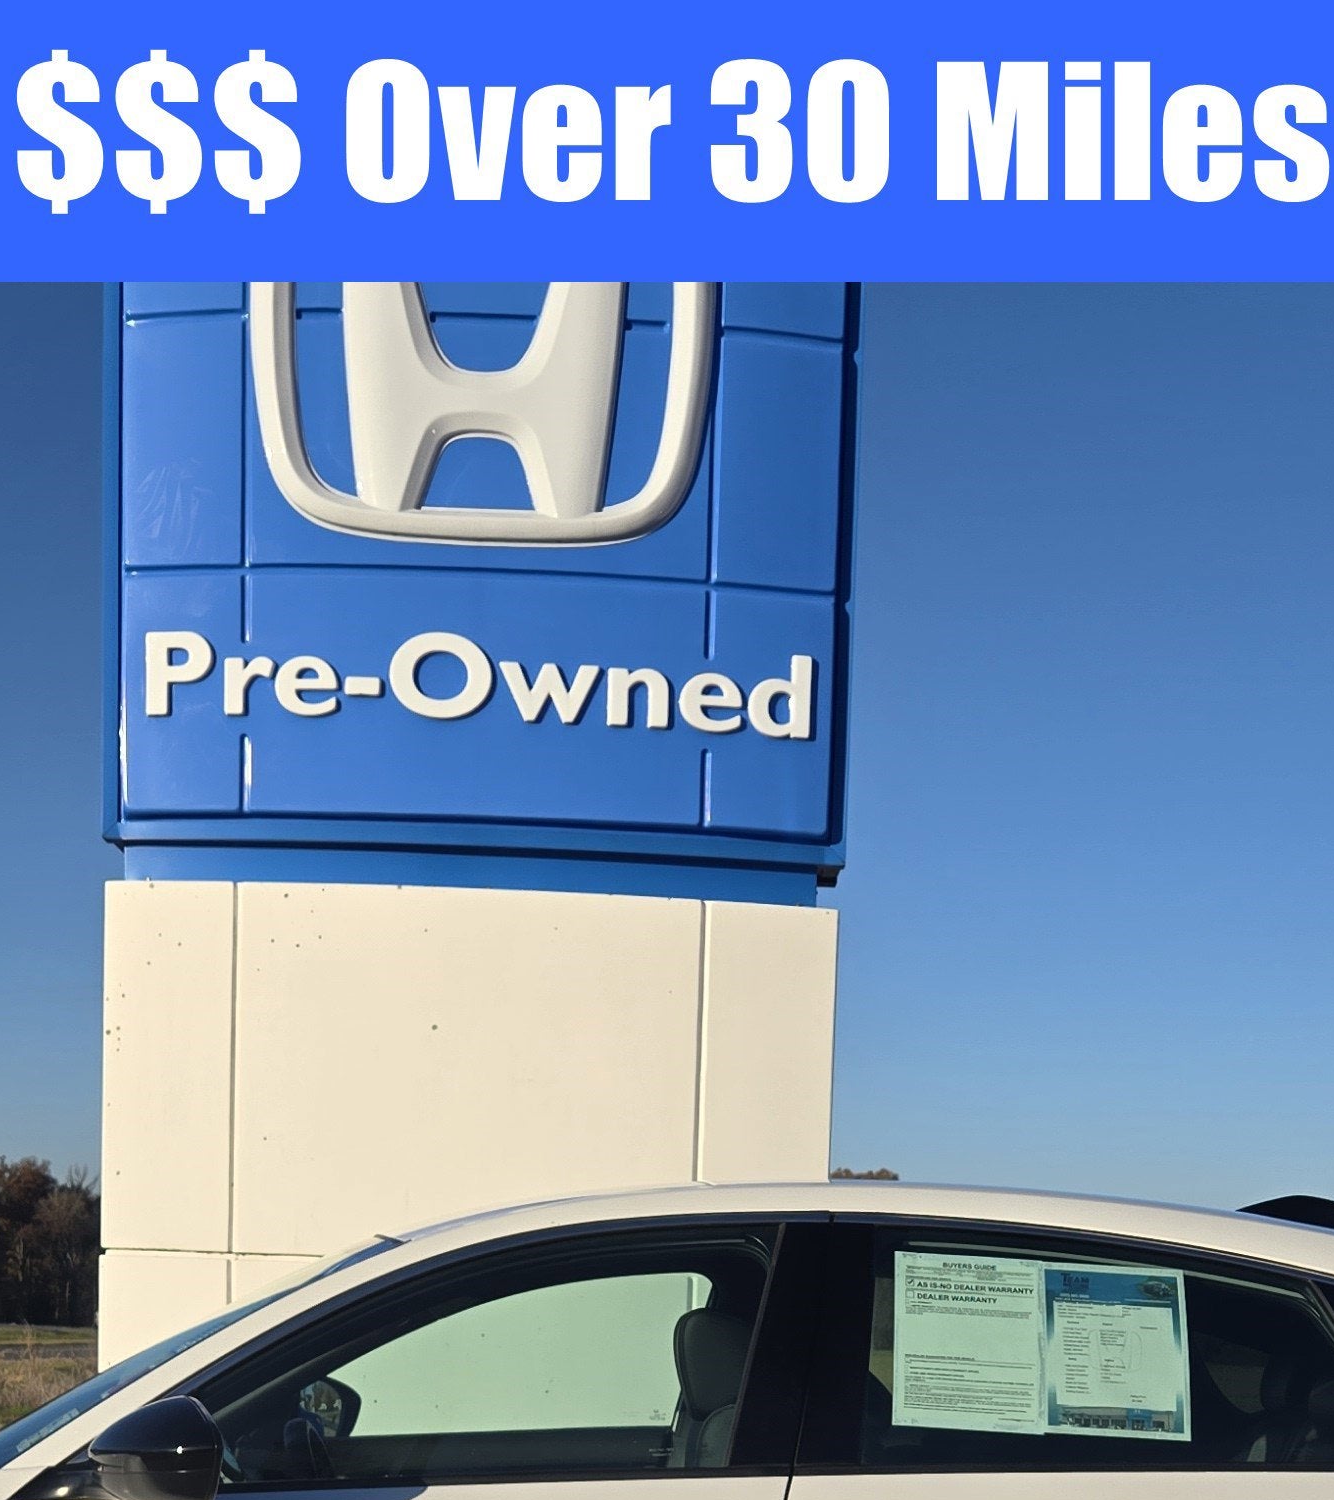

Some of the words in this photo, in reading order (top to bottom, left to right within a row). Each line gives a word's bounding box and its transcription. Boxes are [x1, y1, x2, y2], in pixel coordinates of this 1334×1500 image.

[144, 631, 815, 740] Pre-Owned
[942, 1262, 972, 1270] BUYERS
[954, 1284, 986, 1292] DEALER
[987, 1285, 1034, 1294] WARRANTY
[917, 1293, 949, 1301] DEALER
[951, 1295, 997, 1304] WARRANTY
